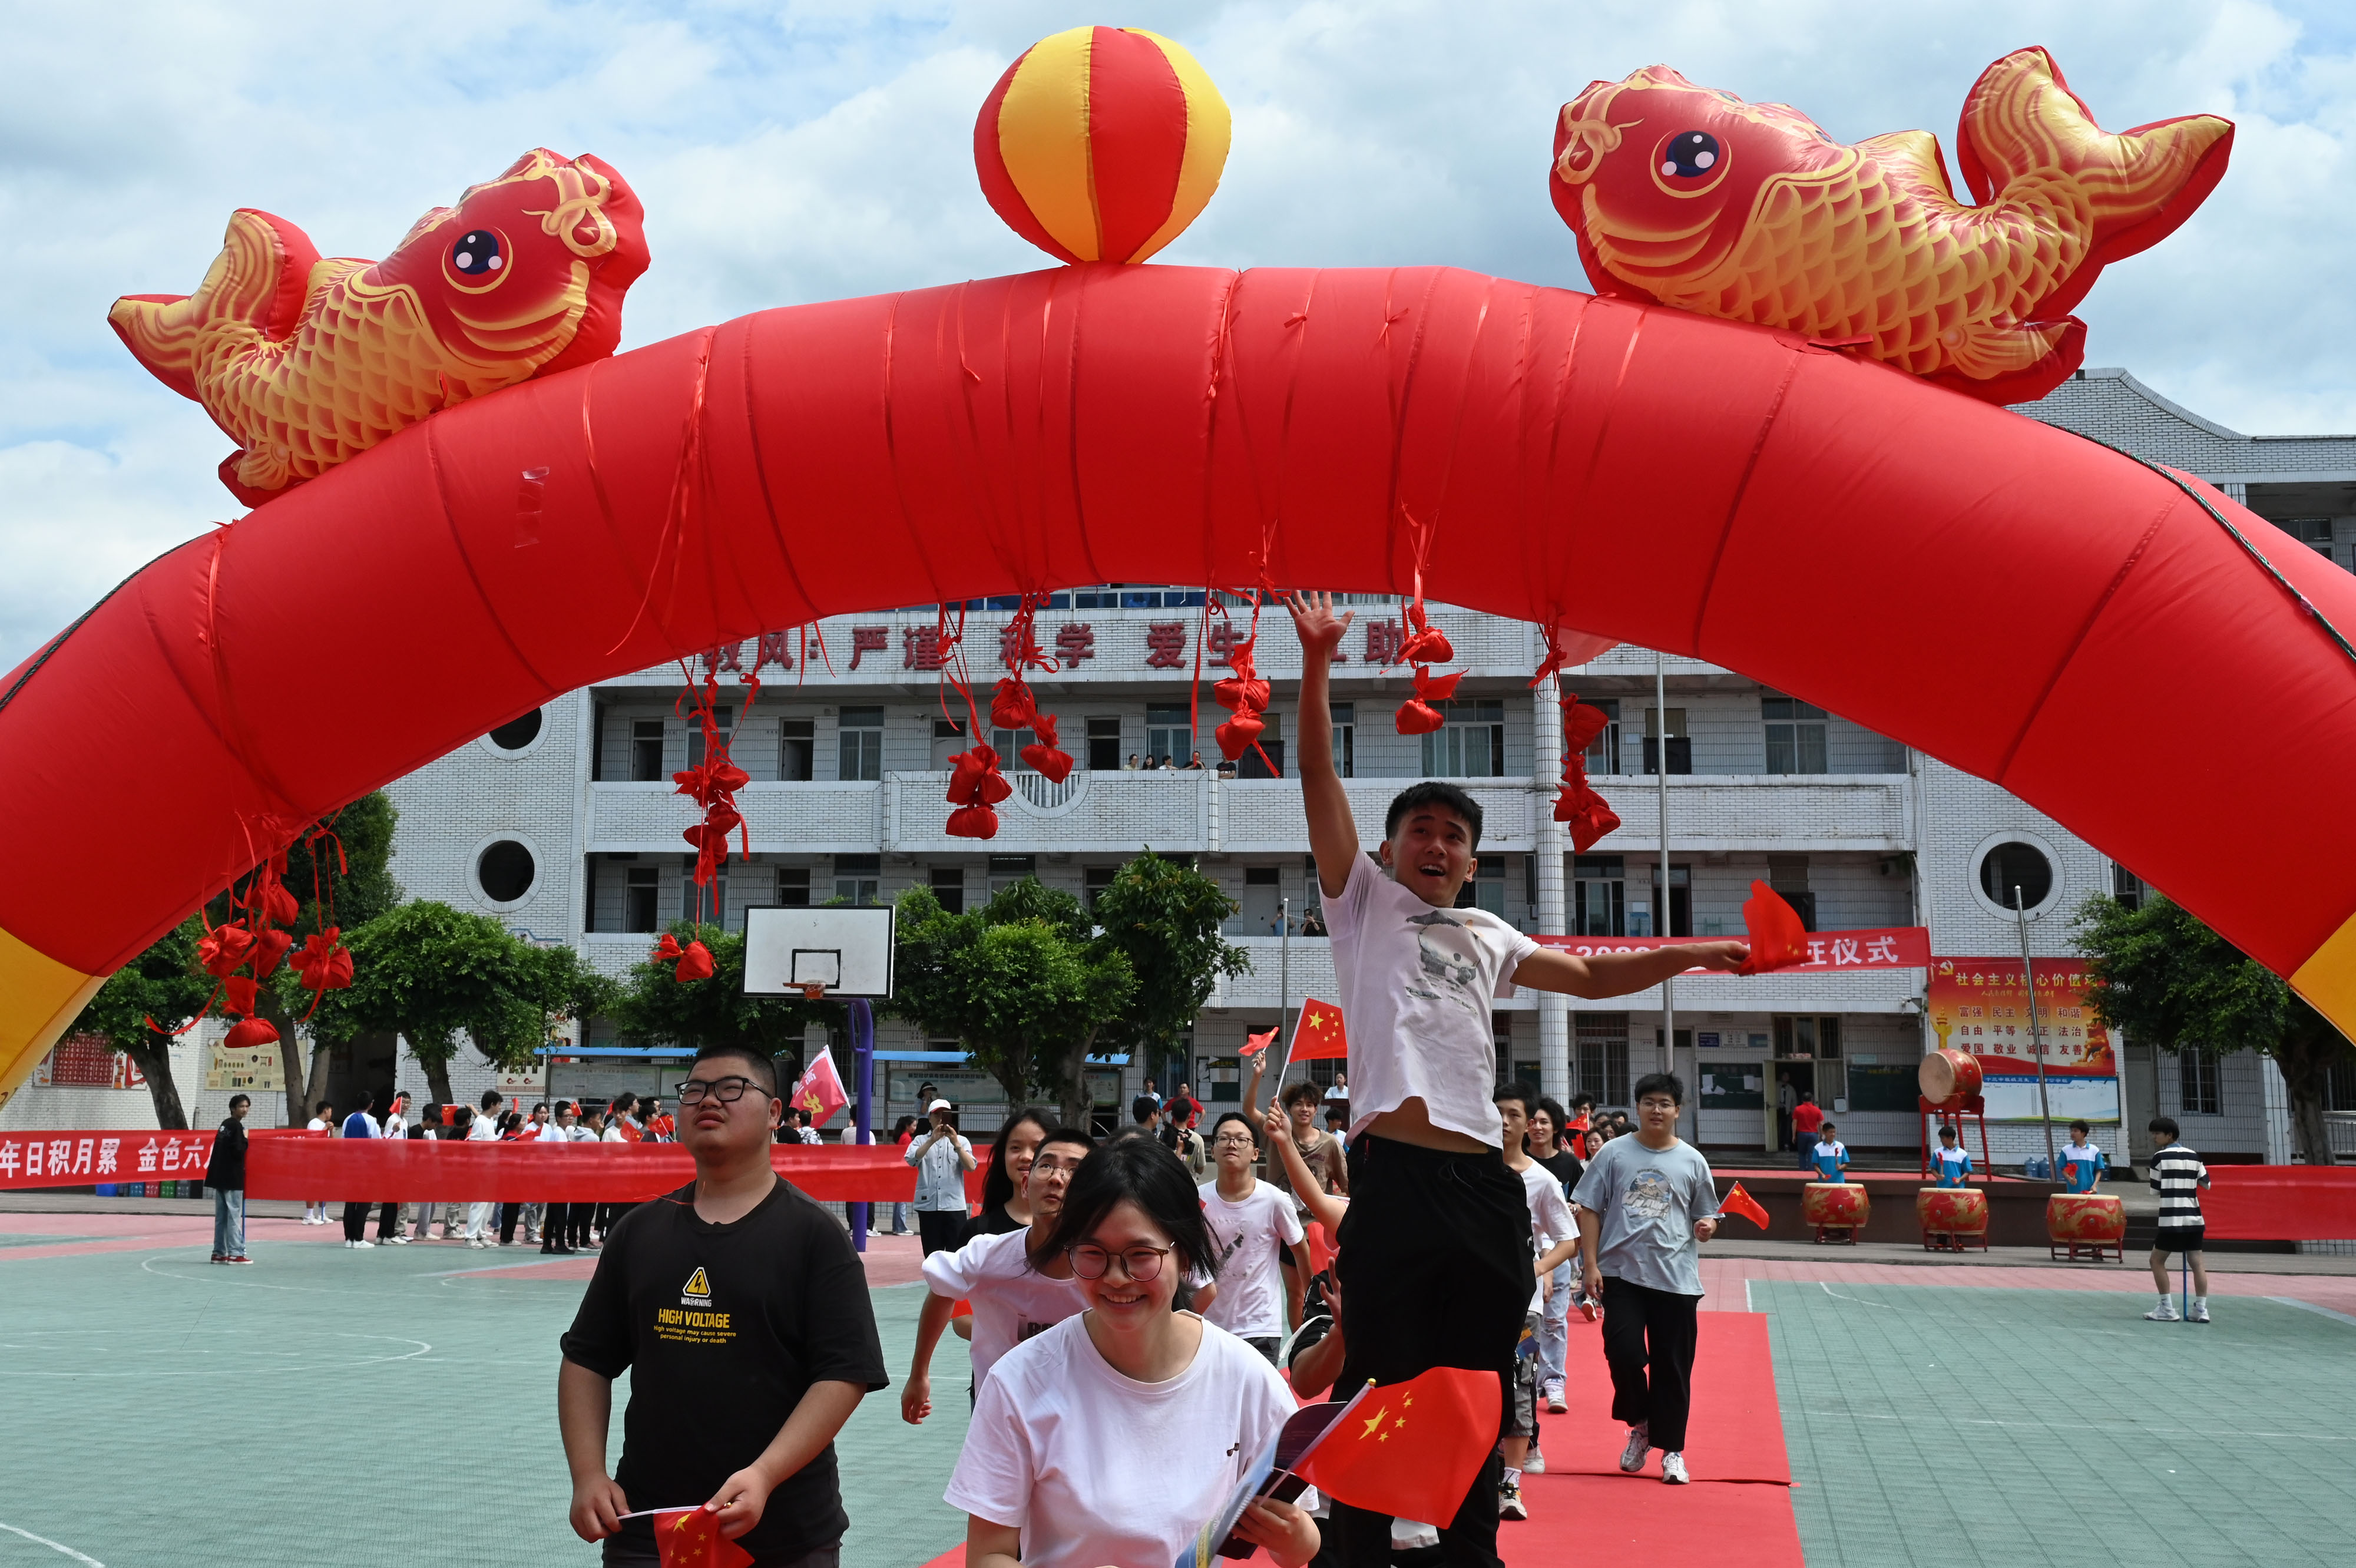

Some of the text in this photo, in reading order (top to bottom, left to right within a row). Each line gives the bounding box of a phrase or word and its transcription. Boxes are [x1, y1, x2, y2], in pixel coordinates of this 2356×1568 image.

[849, 626, 943, 671] 严谨
[1146, 621, 1246, 669] 爱生
[1330, 618, 1404, 665] 助
[1960, 1007, 2082, 1018] 富强 民主 文明 和谐
[1961, 1025, 2082, 1037] 自由 平等 公正 法治
[1961, 1043, 2083, 1056] 爱国 敬业 诚信 友善
[0, 1138, 121, 1178] 年日积月累
[658, 1308, 730, 1328] HIGH VOLTAGE
[684, 1335, 700, 1344] injury
